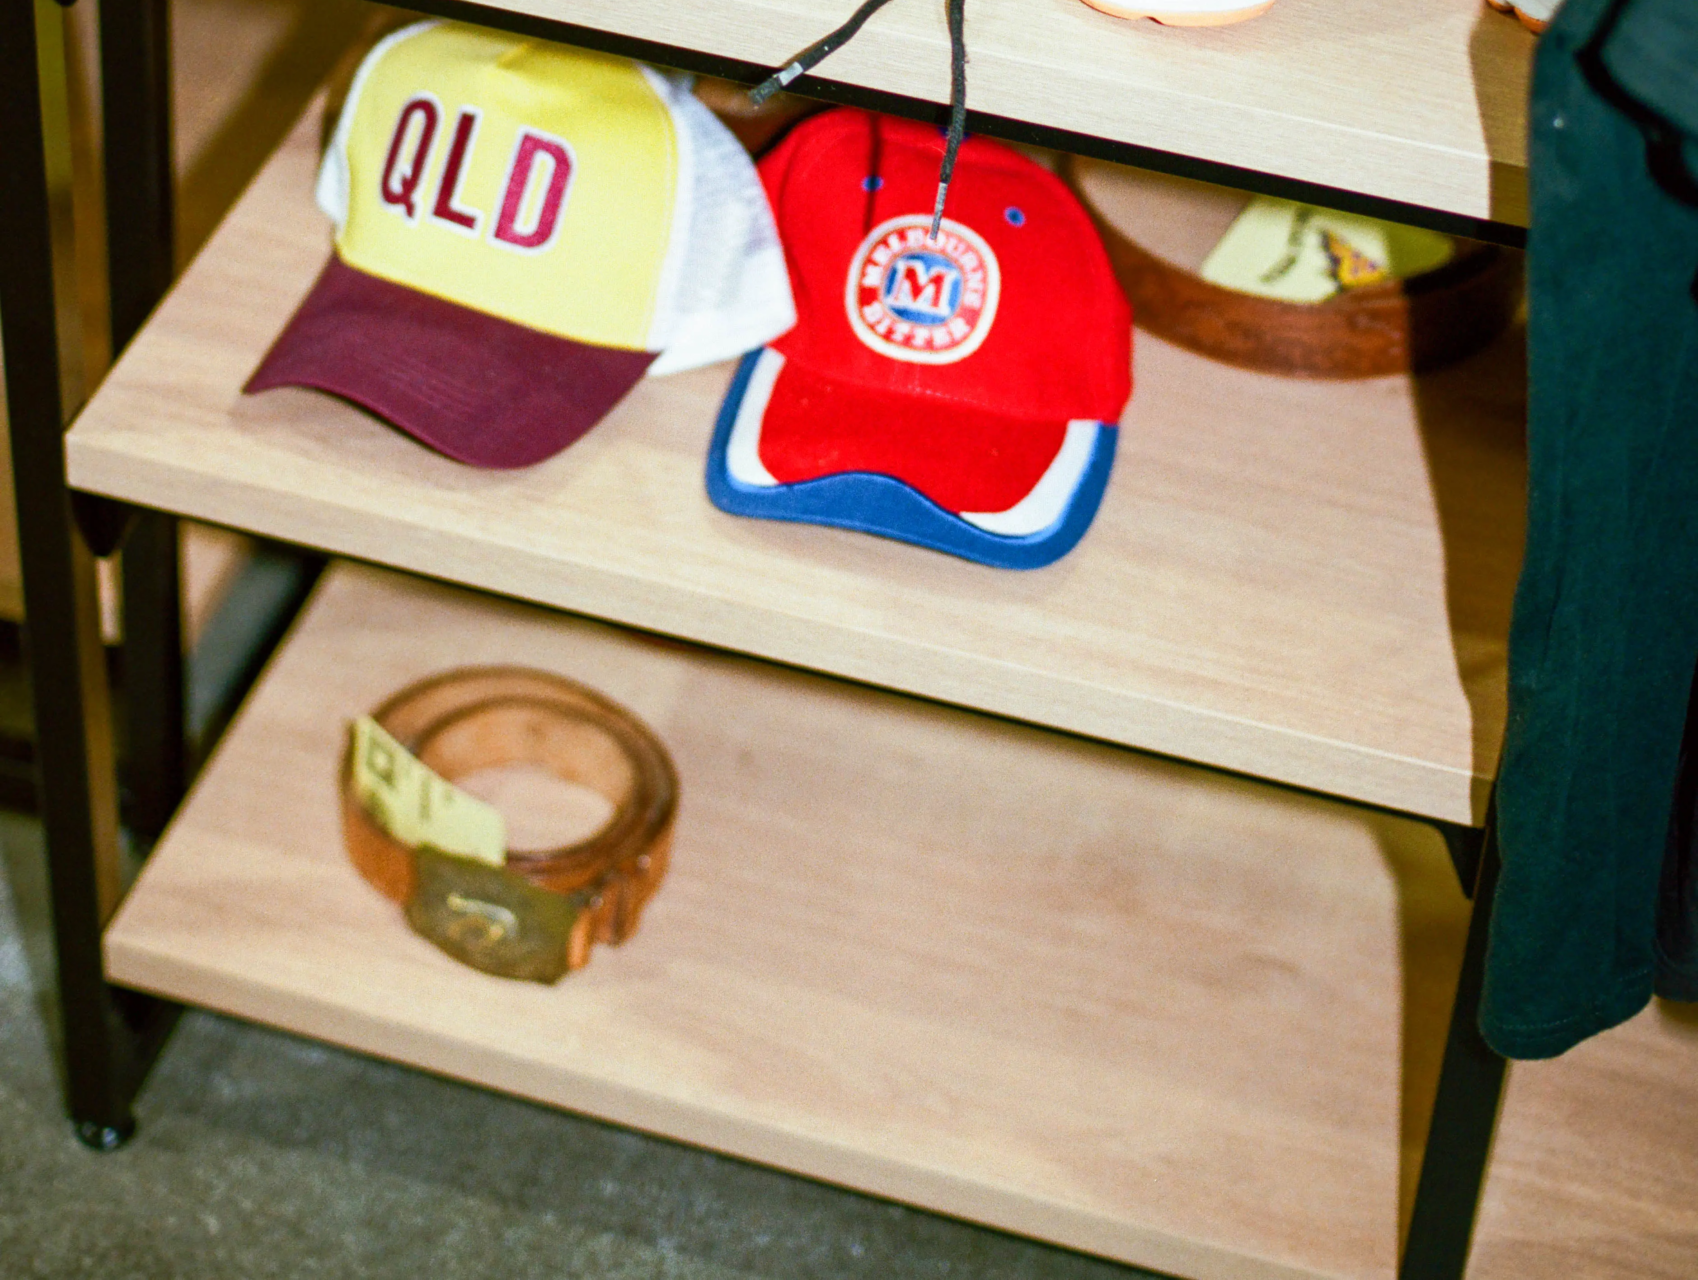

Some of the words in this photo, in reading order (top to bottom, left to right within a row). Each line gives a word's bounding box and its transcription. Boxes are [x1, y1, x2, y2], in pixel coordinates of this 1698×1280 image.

[378, 94, 574, 252] QLD
[861, 228, 985, 308] MELBOURNE
[882, 259, 958, 317] M
[861, 300, 972, 348] BITTER
